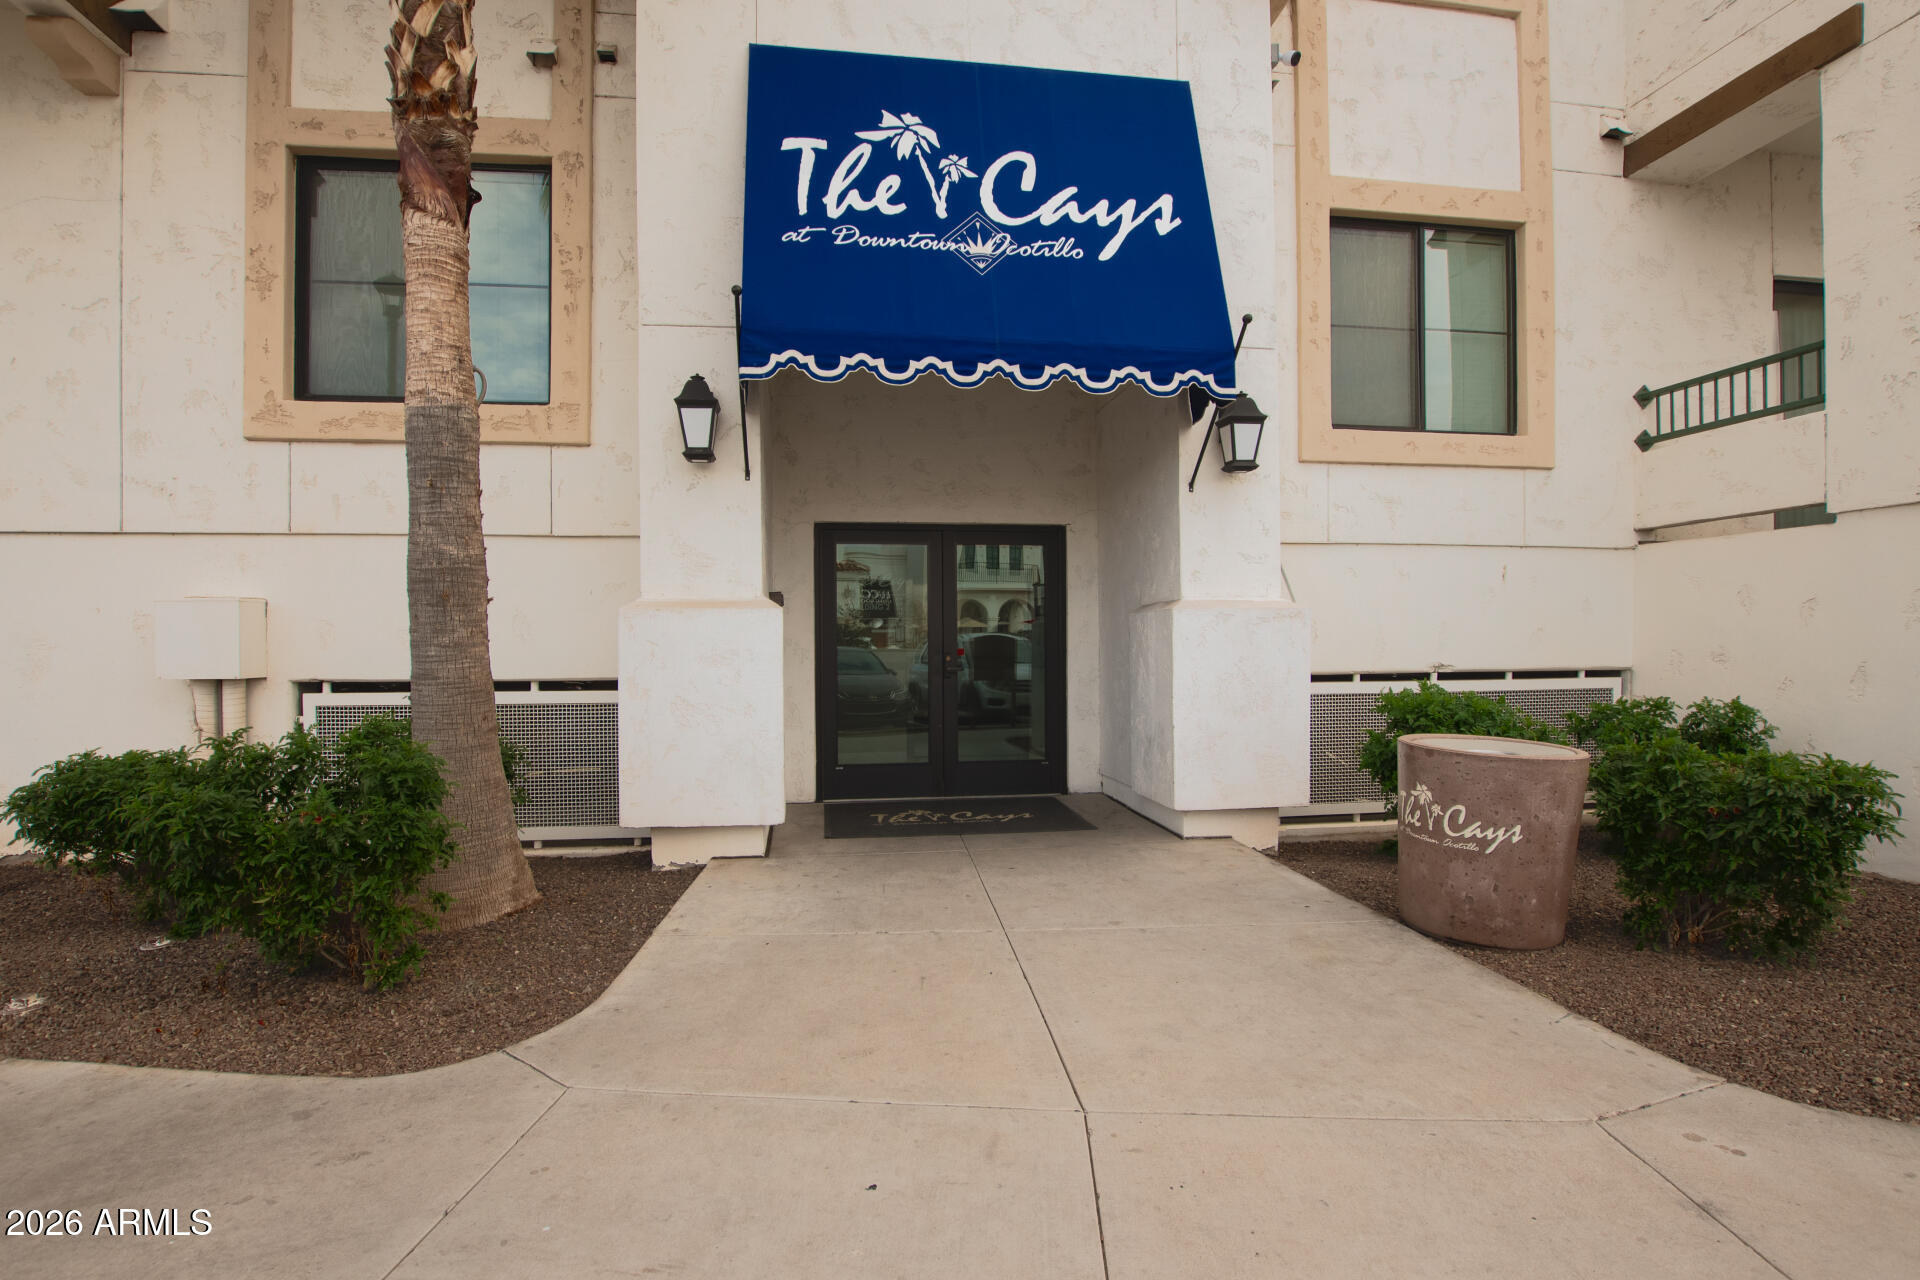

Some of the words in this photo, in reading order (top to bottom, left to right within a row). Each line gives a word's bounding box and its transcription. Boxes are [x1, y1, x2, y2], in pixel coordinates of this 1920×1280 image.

[781, 137, 908, 219] The
[979, 151, 1182, 261] Cays
[781, 225, 826, 243] at
[832, 224, 971, 252] Downtown
[990, 233, 1084, 260] Ocotillo
[950, 811, 1034, 822] Cays
[1400, 790, 1422, 827] The
[1443, 804, 1523, 854] Cays
